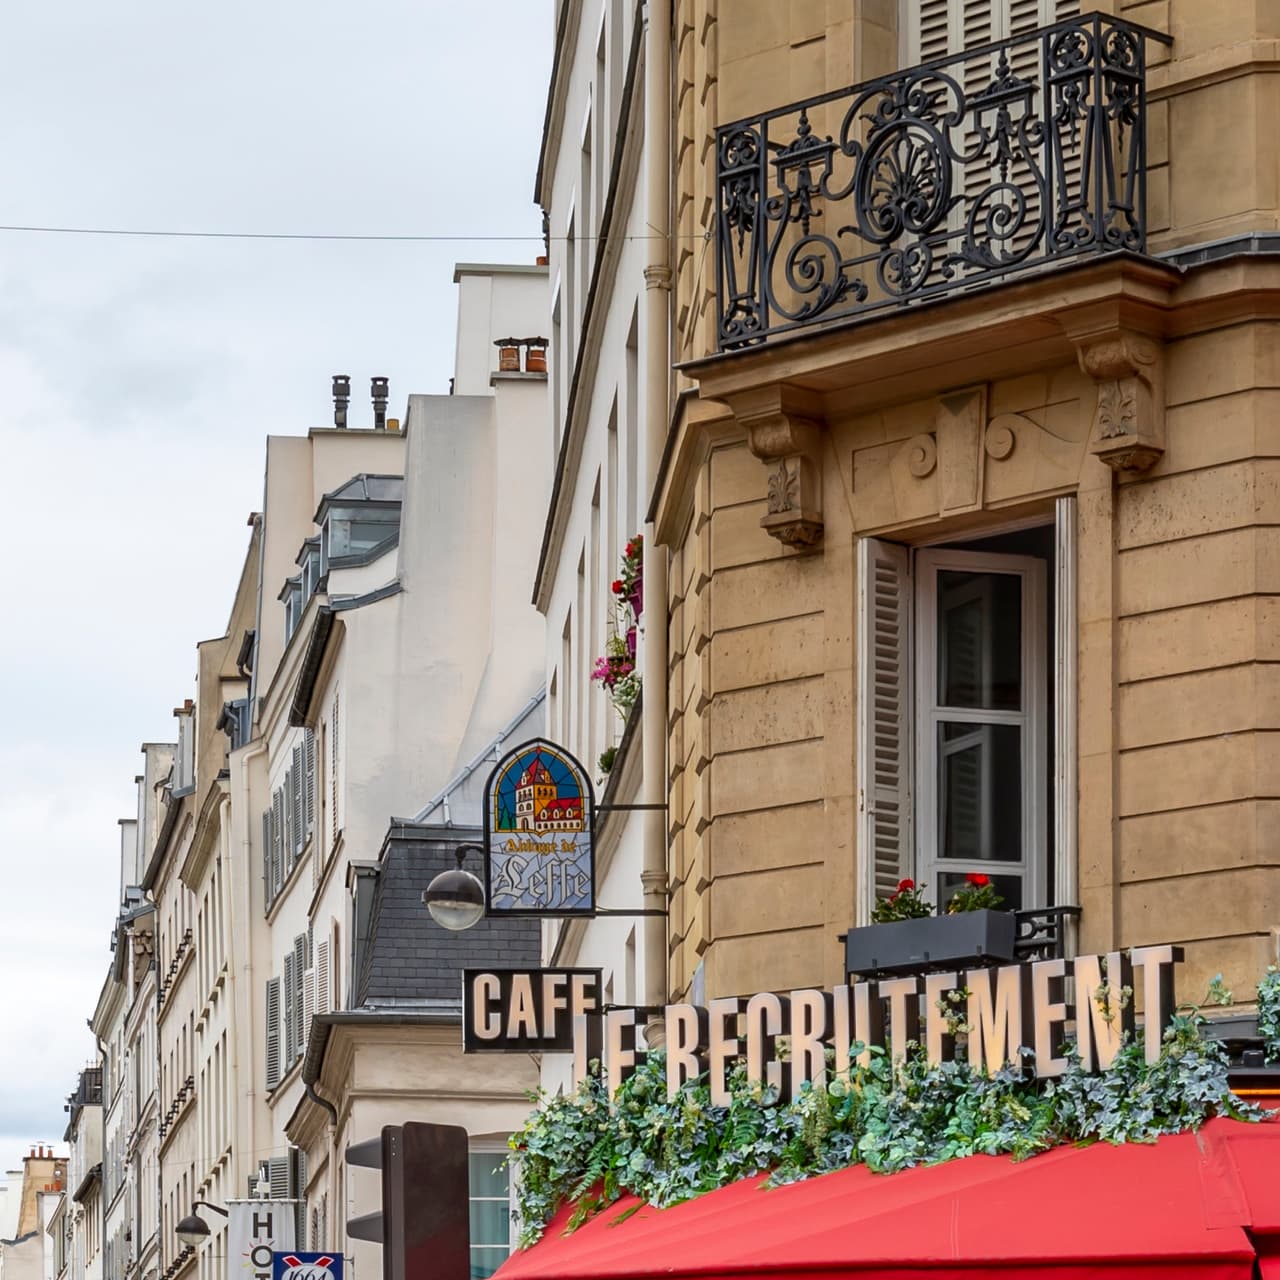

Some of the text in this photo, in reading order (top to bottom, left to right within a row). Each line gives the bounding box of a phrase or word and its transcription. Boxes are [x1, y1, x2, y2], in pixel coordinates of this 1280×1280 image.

[491, 854, 590, 907] Leffe
[472, 973, 598, 1041] CAFE
[665, 944, 1176, 1109] RECRUTEMENT
